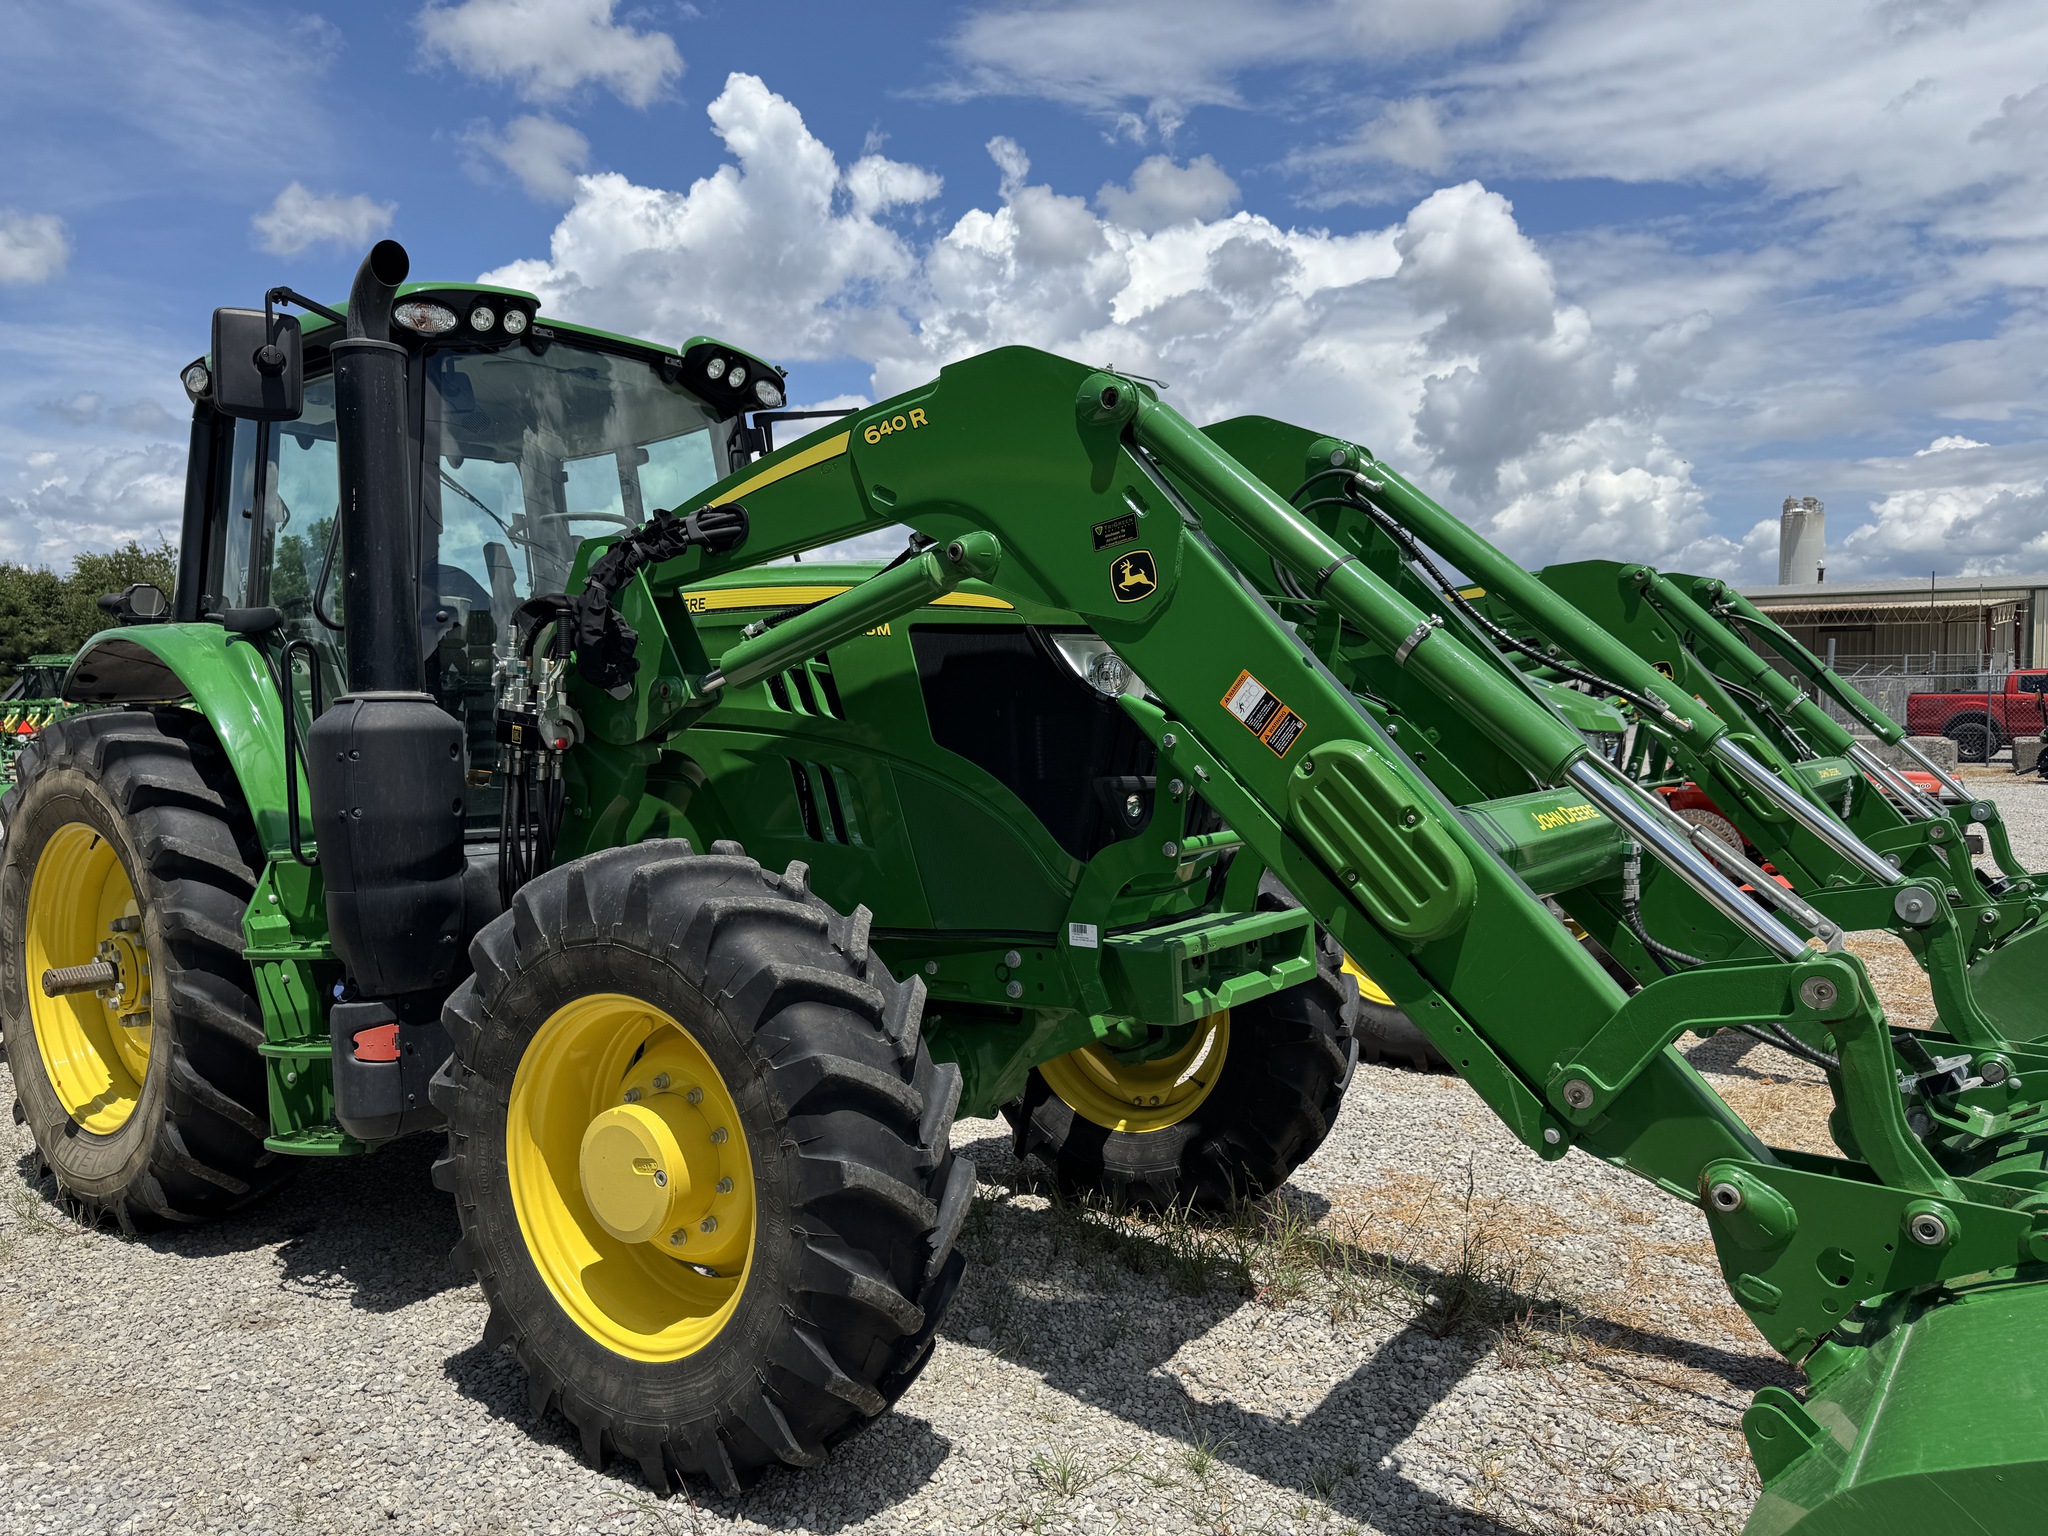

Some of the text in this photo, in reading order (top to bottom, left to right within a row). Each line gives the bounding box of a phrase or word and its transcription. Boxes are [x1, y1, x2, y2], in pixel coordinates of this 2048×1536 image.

[684, 597, 706, 610] RE
[1228, 674, 1246, 698] WARNING
[1269, 710, 1287, 733] WARNING
[1531, 804, 1601, 831] JOHN DEERE
